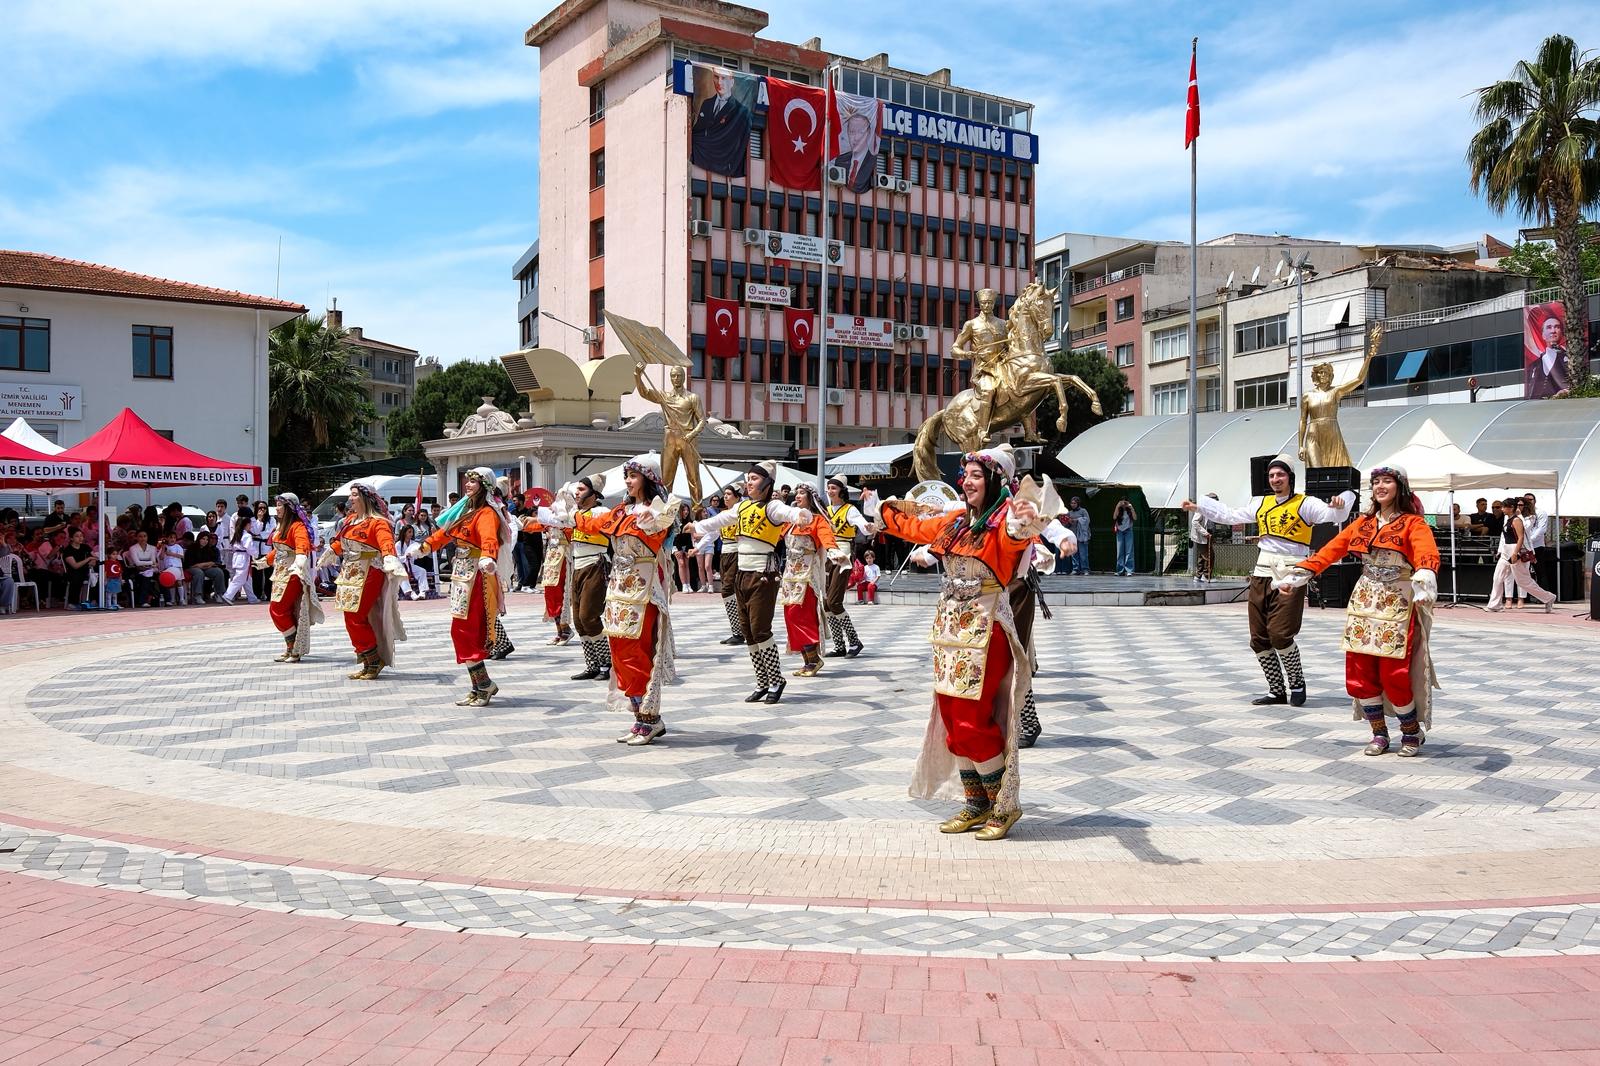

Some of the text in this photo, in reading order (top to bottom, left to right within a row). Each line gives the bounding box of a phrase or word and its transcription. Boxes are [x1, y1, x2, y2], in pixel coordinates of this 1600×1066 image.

[882, 104, 913, 135] İLÇE
[917, 114, 1006, 153] BAŞKANLIĞI
[10, 464, 84, 478] BELEDİYESİ
[131, 470, 249, 483] MENEMEN BELEDİYESİ
